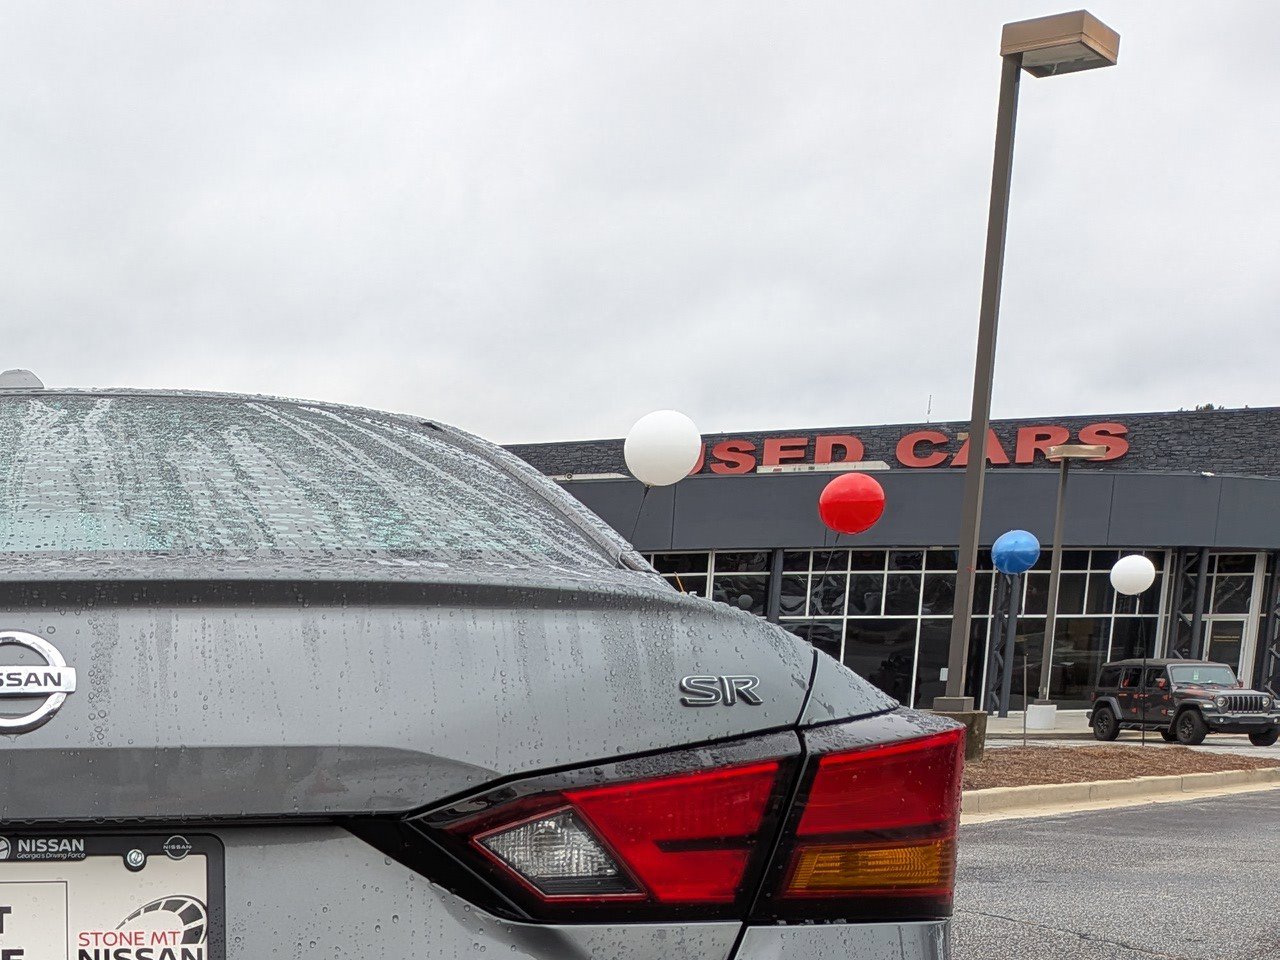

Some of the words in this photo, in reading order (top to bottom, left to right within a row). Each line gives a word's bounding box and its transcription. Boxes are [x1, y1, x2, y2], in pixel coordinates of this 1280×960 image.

[688, 434, 865, 475] SED
[895, 422, 1130, 467] CARS
[680, 674, 763, 706] SR
[17, 838, 86, 852] NISSAN
[16, 852, 46, 860] Georgia's
[46, 852, 67, 860] Driving
[68, 851, 86, 859] Force
[78, 931, 145, 946] STONE
[150, 931, 181, 946] MT
